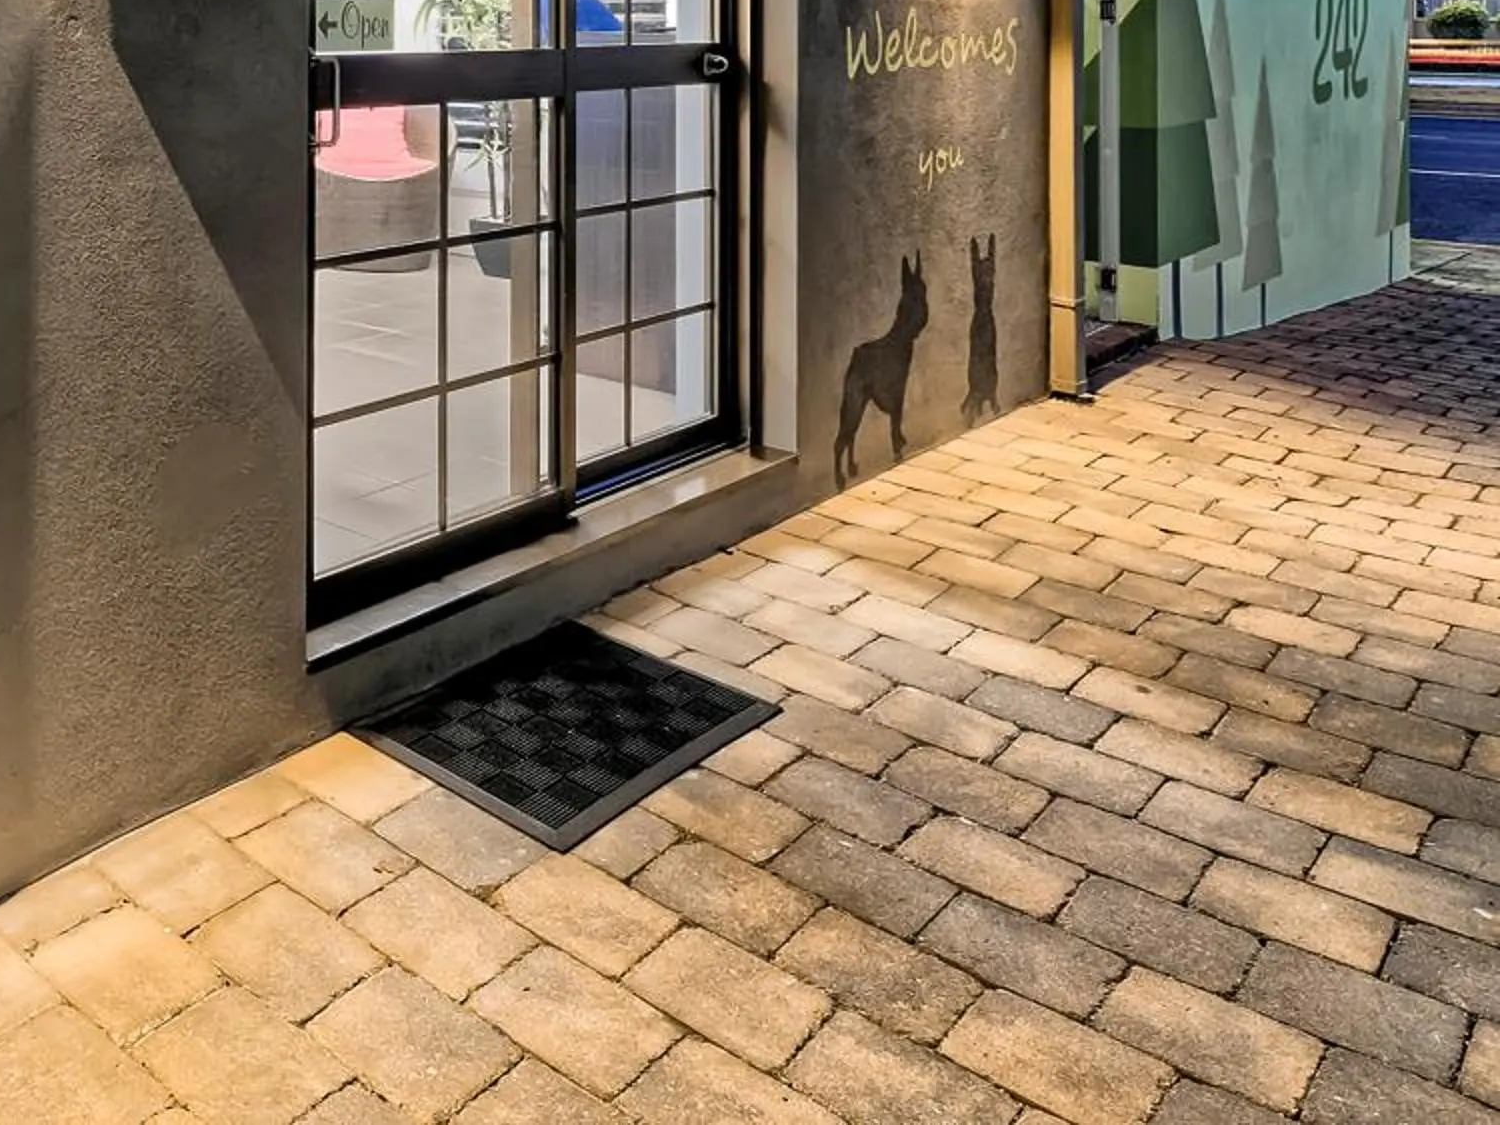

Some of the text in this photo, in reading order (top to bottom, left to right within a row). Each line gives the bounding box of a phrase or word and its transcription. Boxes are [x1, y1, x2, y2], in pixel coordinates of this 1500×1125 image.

[341, 0, 390, 50] Open
[845, 6, 1019, 80] Welcomes
[918, 144, 965, 193] you
